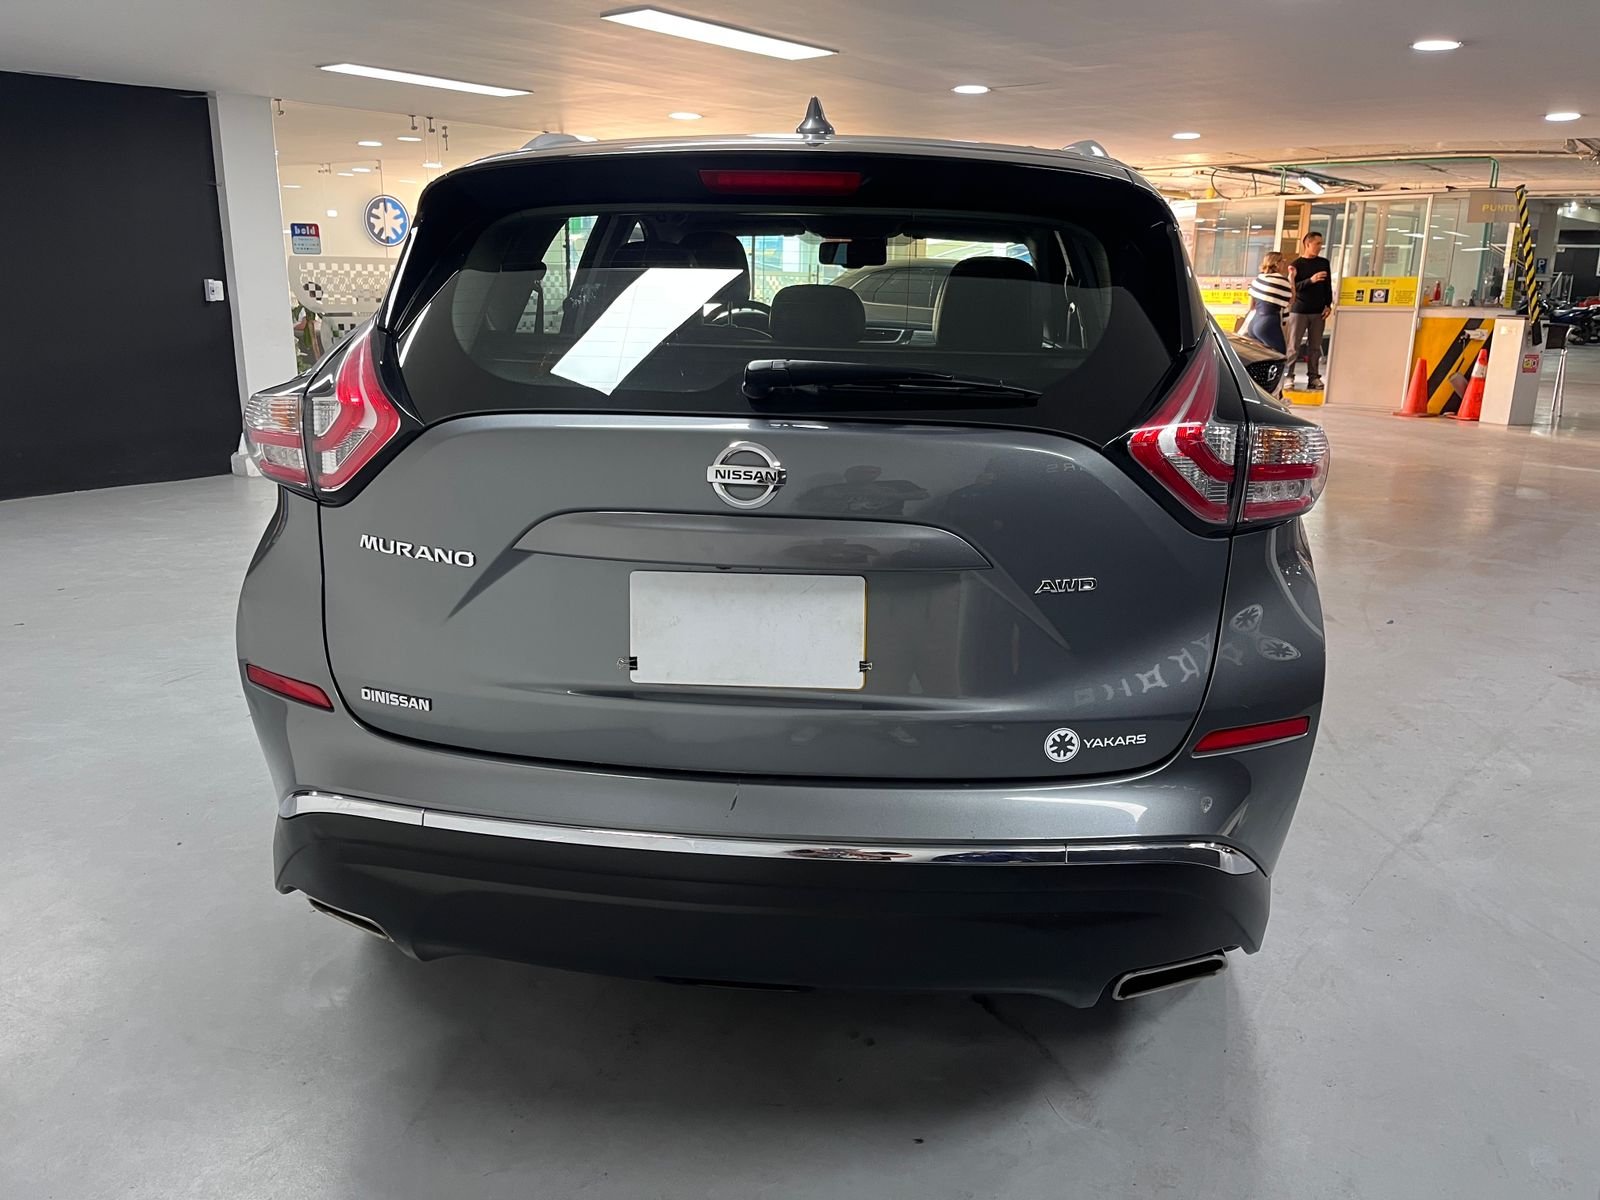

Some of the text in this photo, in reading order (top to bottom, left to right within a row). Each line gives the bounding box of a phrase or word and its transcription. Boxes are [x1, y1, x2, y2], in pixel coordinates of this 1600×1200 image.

[1482, 203, 1517, 212] PUNTO
[294, 225, 316, 235] bold
[715, 469, 777, 482] NISSAN
[359, 534, 475, 567] MURANO
[1034, 577, 1098, 594] AWD
[360, 687, 431, 711] DINISSAN
[1083, 733, 1147, 749] YAKARS
